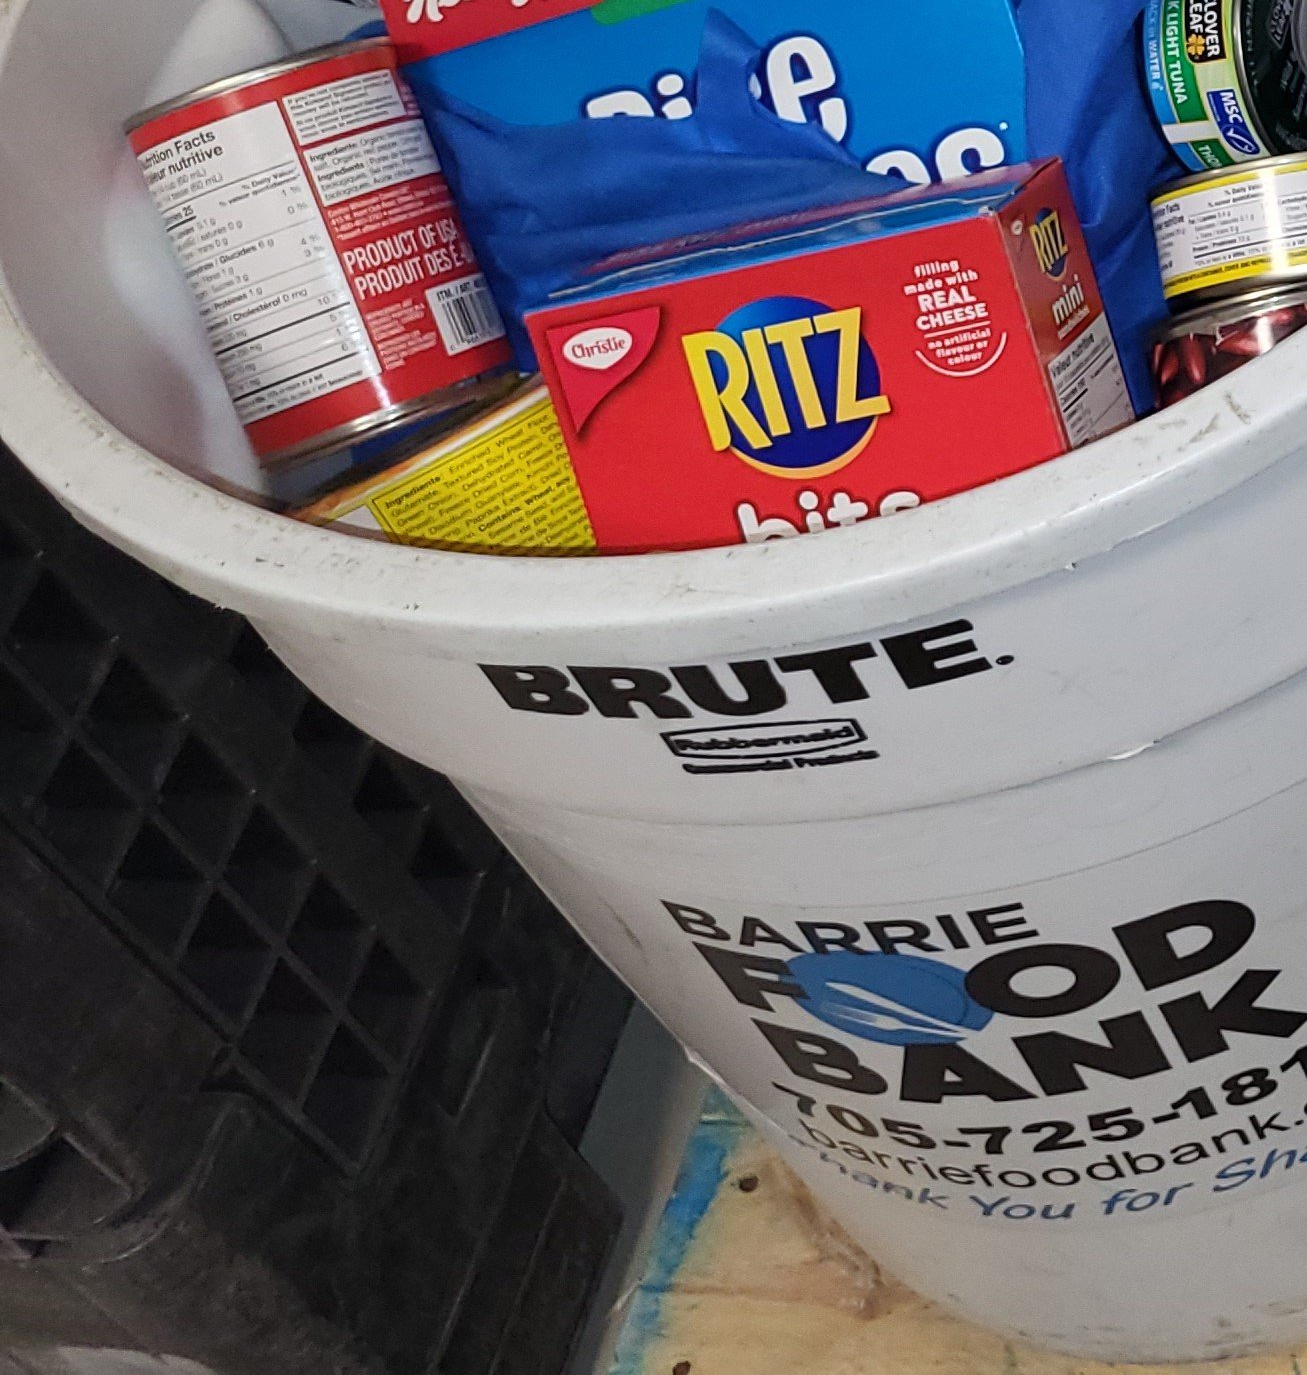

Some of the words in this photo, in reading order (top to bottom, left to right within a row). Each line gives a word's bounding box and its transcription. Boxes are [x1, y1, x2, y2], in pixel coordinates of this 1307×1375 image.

[1164, 13, 1182, 58] LIGHT
[1149, 38, 1161, 82] WATER
[1168, 59, 1189, 105] TUNA
[1219, 91, 1244, 125] MSC
[168, 145, 224, 176] nutritive
[174, 130, 216, 155] Facts
[342, 228, 419, 275] PRODUCT
[418, 223, 439, 250] OF
[1029, 210, 1069, 275] RITZ
[353, 256, 425, 301] PRODUIT
[424, 246, 453, 276] DES
[903, 277, 943, 295] made
[945, 269, 979, 286] with
[915, 302, 989, 331] CHEESE
[917, 285, 977, 313] REAL
[1052, 273, 1086, 325] mini
[570, 330, 627, 362] Christie
[681, 306, 892, 453] RITZ
[659, 899, 1042, 958] BARRIE
[690, 897, 1257, 1019] FOOD
[969, 1194, 1076, 1220] You
[1102, 1180, 1198, 1219] for
